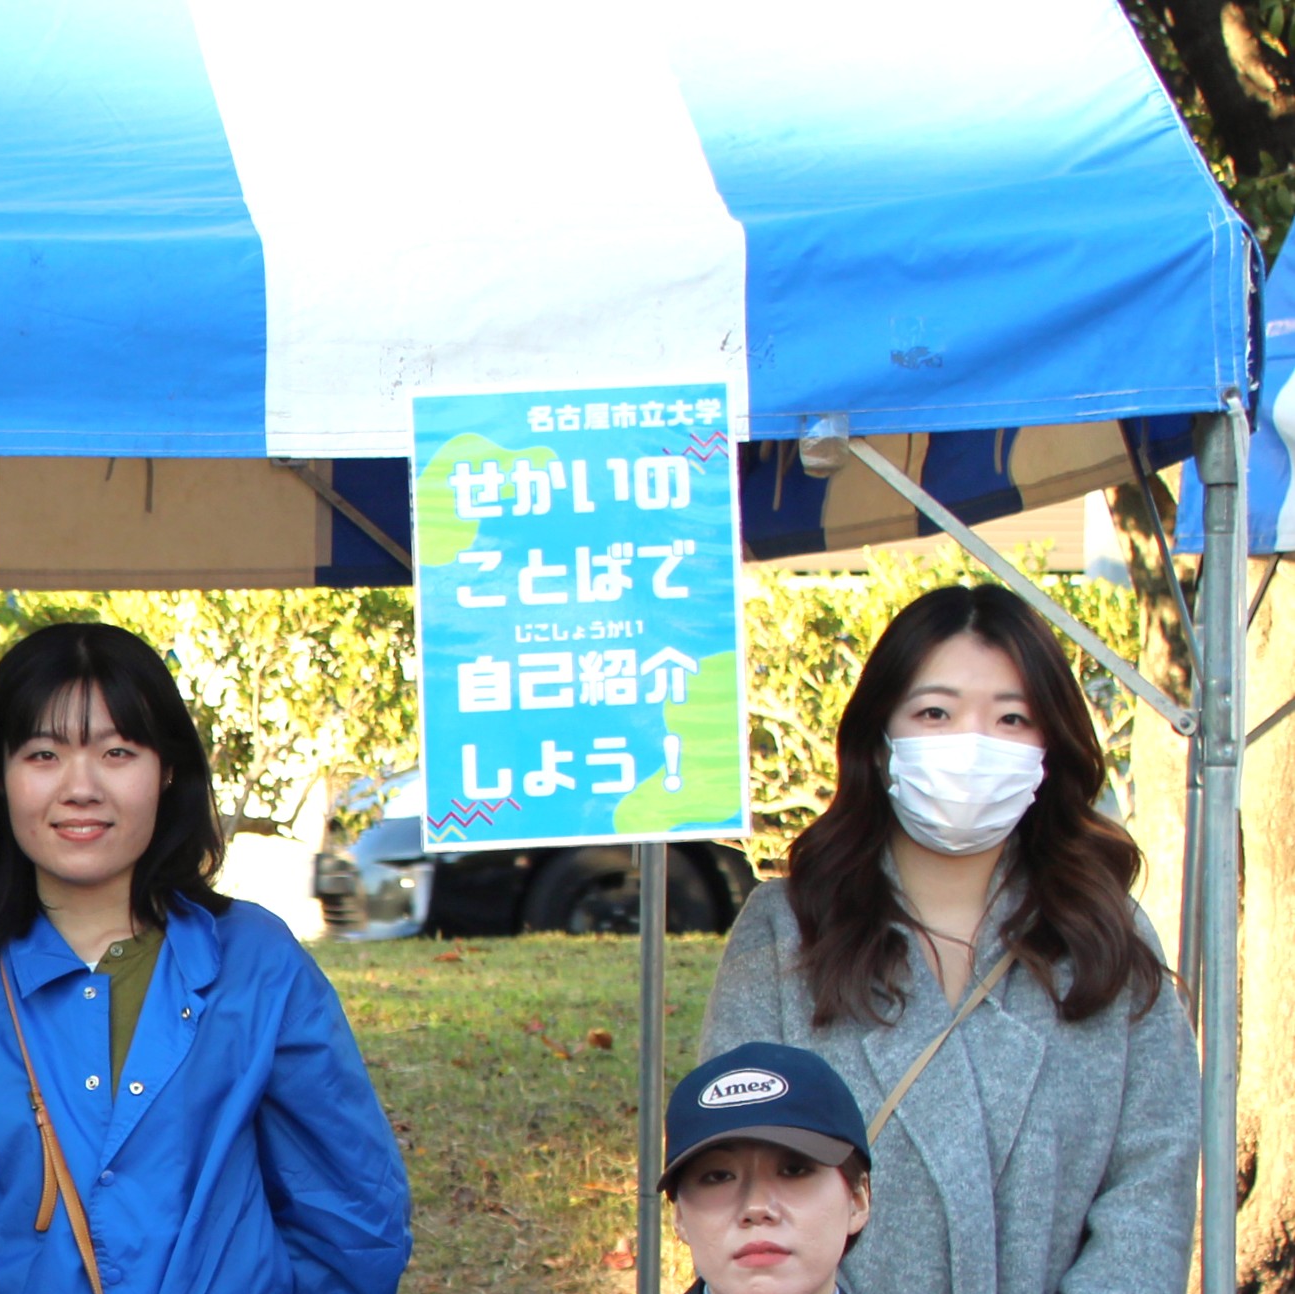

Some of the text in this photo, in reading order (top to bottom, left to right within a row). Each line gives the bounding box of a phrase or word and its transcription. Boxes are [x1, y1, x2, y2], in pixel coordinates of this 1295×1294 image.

[527, 399, 722, 432] 名古屋市立大学
[449, 455, 691, 520] せかいの
[456, 539, 696, 608] ことばで
[515, 619, 644, 643] じこしょうかい
[457, 646, 698, 713] 自己紹介
[461, 734, 683, 800] しよう！
